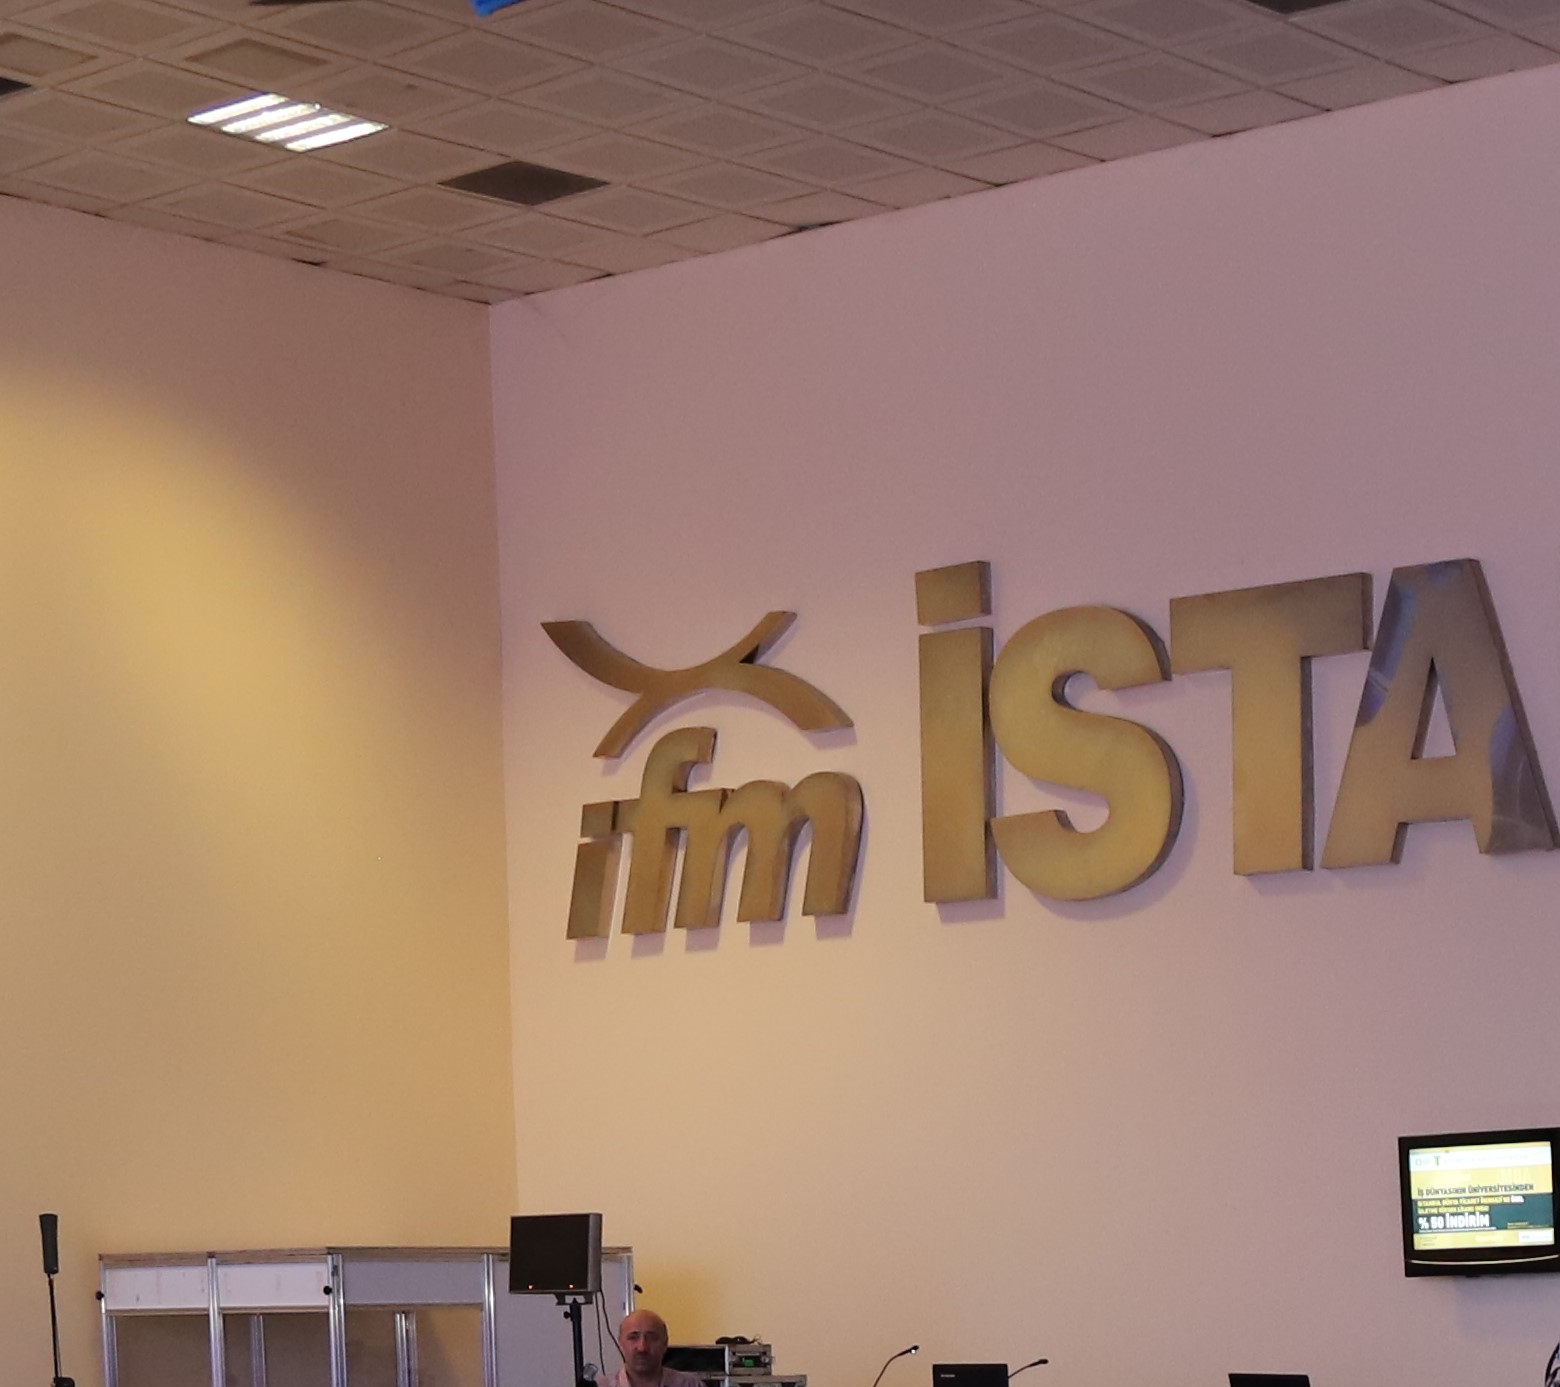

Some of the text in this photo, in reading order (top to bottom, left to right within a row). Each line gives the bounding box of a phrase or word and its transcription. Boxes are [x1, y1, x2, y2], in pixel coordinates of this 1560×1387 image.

[564, 722, 866, 942] ifm
[1430, 1216, 1444, 1230] 50
[1445, 1211, 1490, 1229] İNDİRİM
